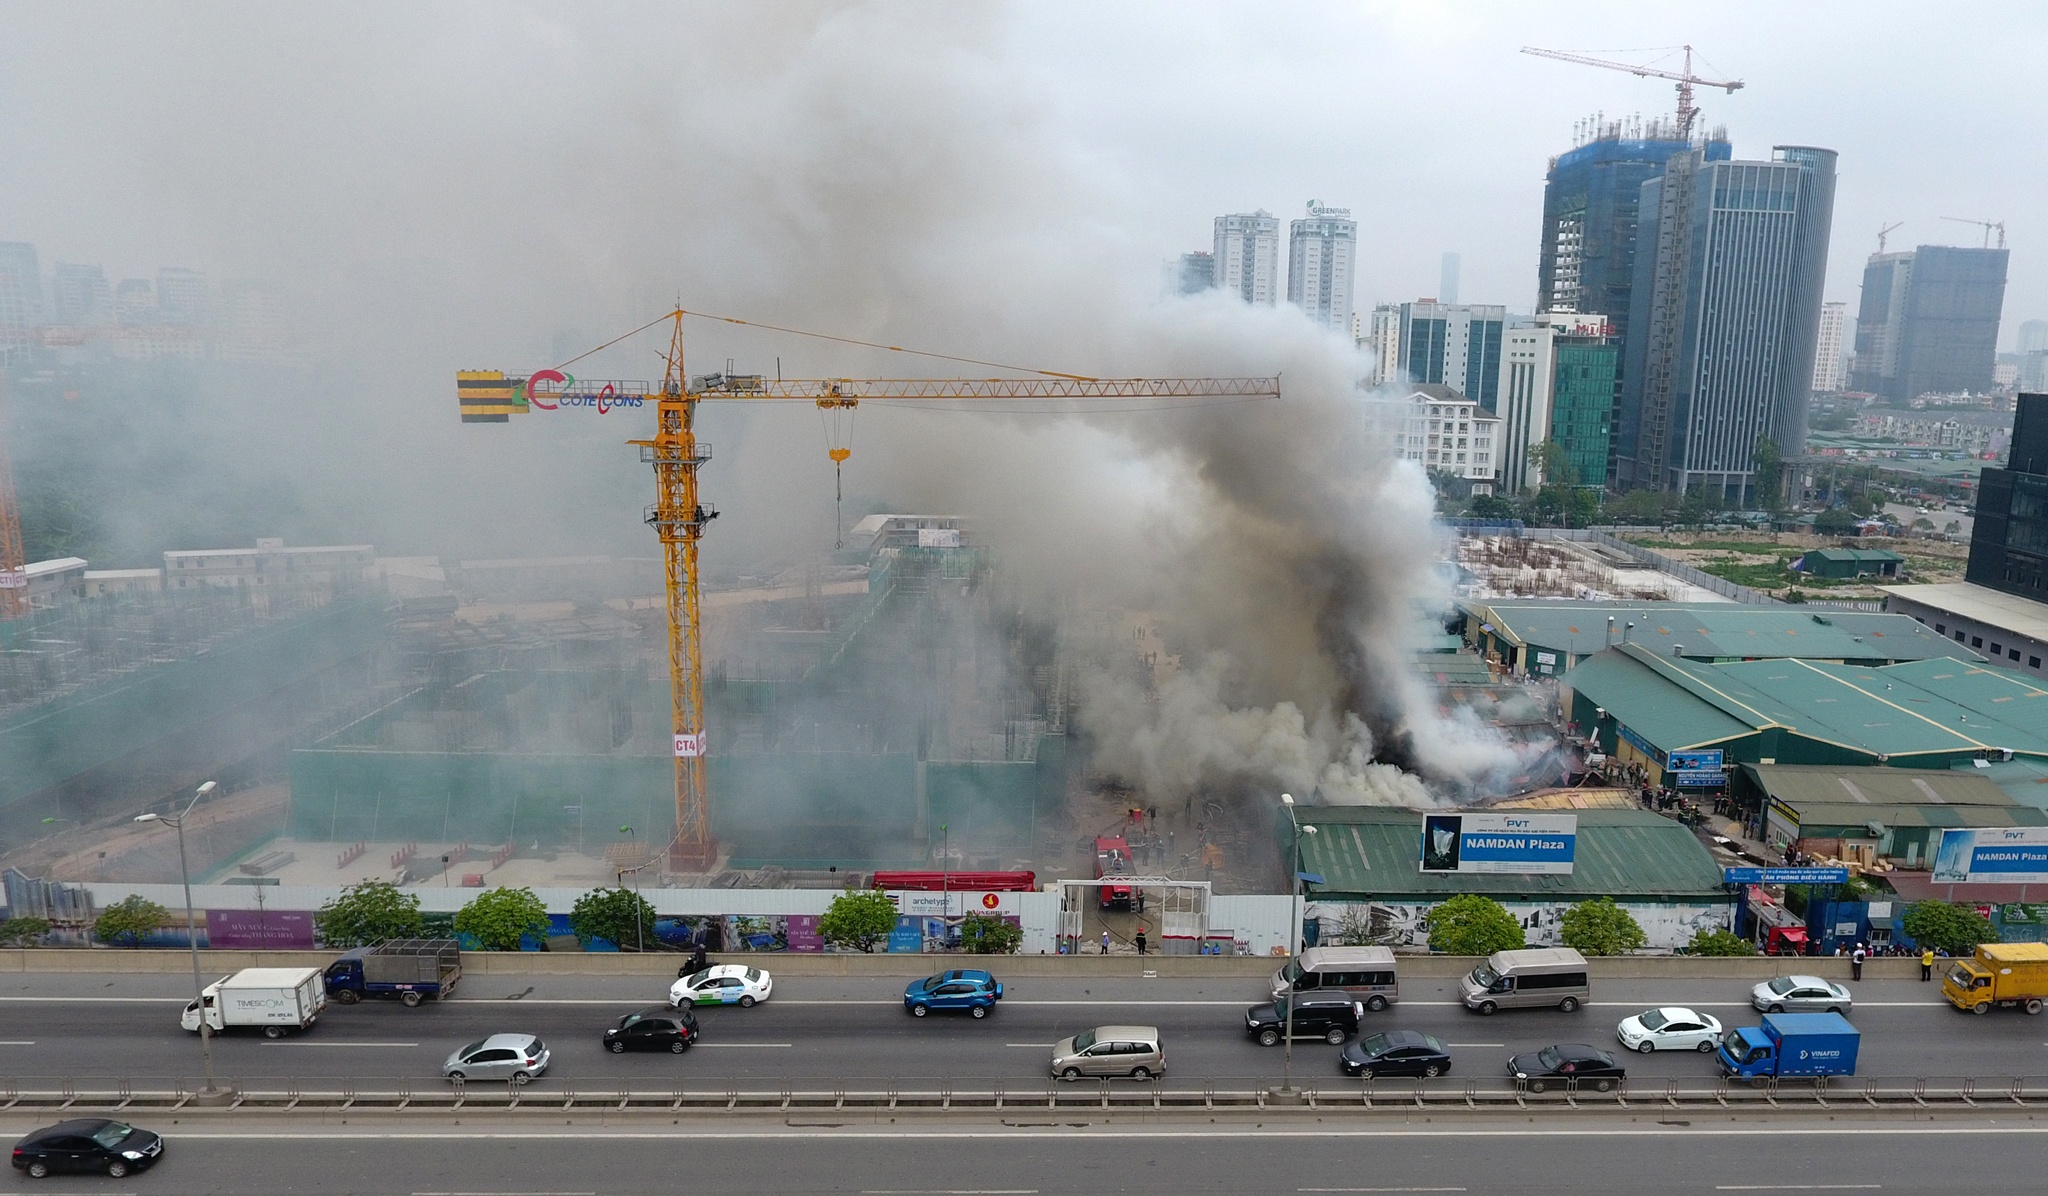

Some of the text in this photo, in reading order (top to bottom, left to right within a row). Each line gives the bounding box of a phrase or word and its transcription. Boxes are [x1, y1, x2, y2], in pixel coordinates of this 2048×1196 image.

[1312, 207, 1351, 215] GREENPARK
[676, 740, 696, 751] CT4
[1466, 838, 1565, 849] NAMDAN Plaza
[1976, 853, 2048, 861] NAMDAN Plaza
[912, 896, 950, 906] archetype
[236, 999, 284, 1008] TIMESCOM
